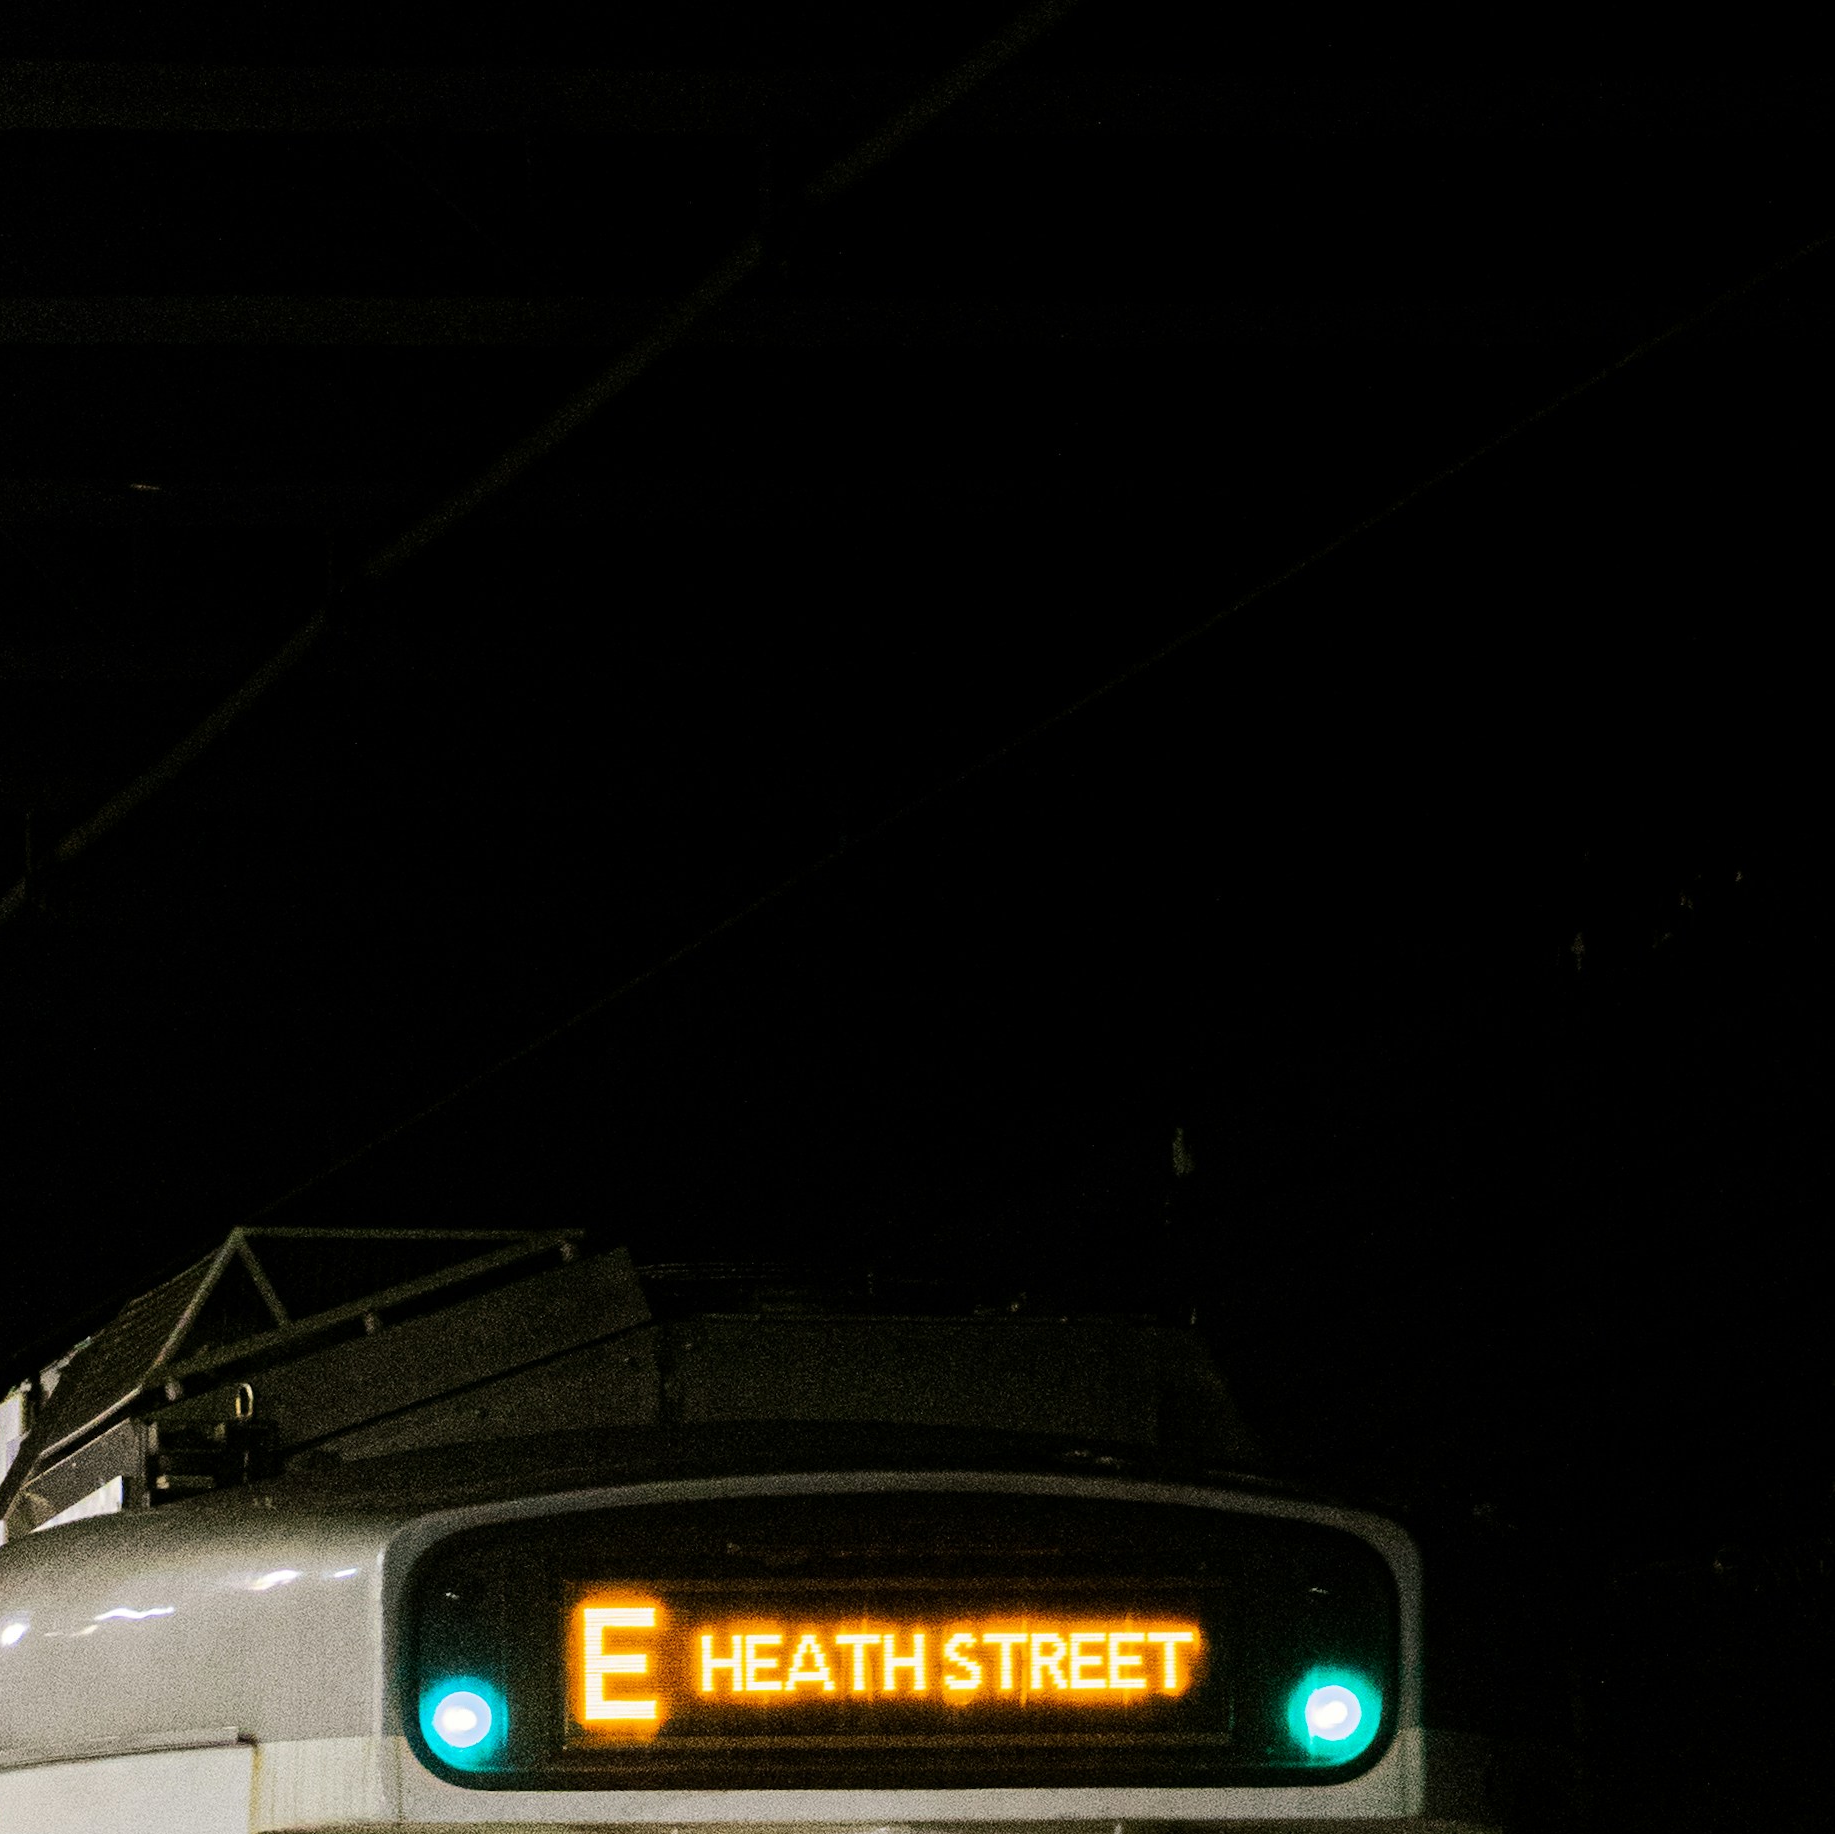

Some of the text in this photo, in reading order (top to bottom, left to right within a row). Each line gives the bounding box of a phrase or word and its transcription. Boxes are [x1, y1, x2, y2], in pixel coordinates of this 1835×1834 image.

[582, 1606, 1194, 1721] E HEATH STREET
